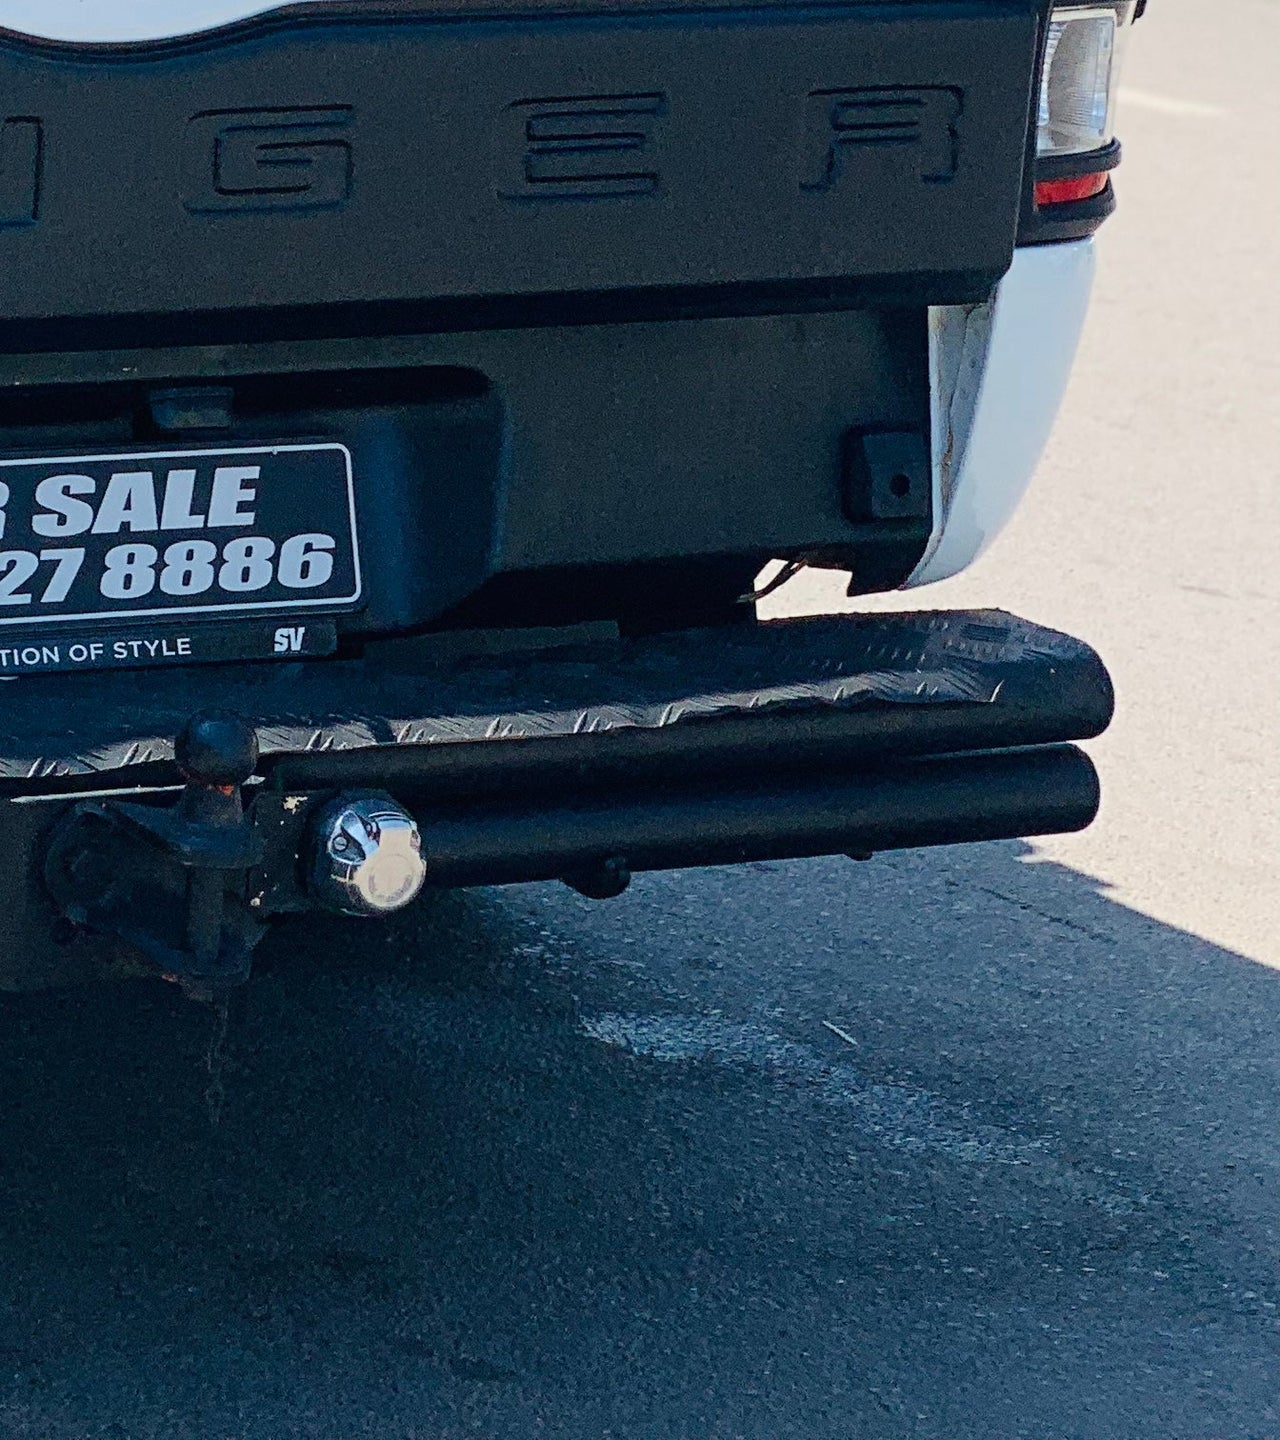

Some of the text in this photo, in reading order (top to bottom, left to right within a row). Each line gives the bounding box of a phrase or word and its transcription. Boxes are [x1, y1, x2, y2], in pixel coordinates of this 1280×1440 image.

[31, 465, 261, 538] SALE
[99, 533, 336, 599] 8886
[68, 643, 104, 662] OF
[113, 637, 192, 659] STYLE
[274, 626, 306, 652] SV
